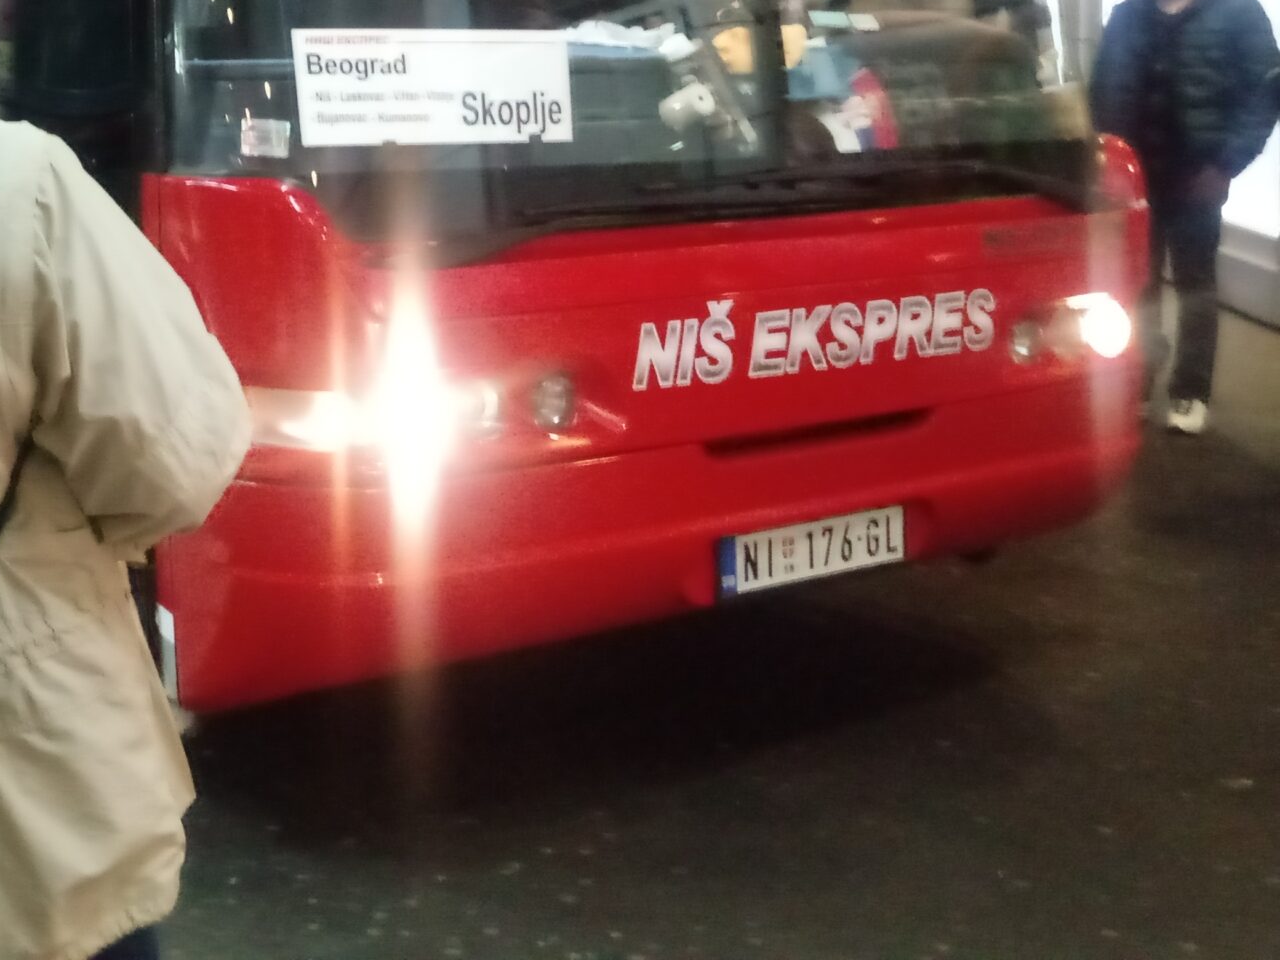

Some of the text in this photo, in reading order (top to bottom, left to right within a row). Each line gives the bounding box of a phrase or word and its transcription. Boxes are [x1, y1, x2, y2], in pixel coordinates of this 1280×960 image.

[306, 52, 407, 80] Beograd
[462, 91, 562, 134] Skoplje
[632, 288, 997, 391] NIŠ EKSPRES
[743, 536, 773, 583] NI
